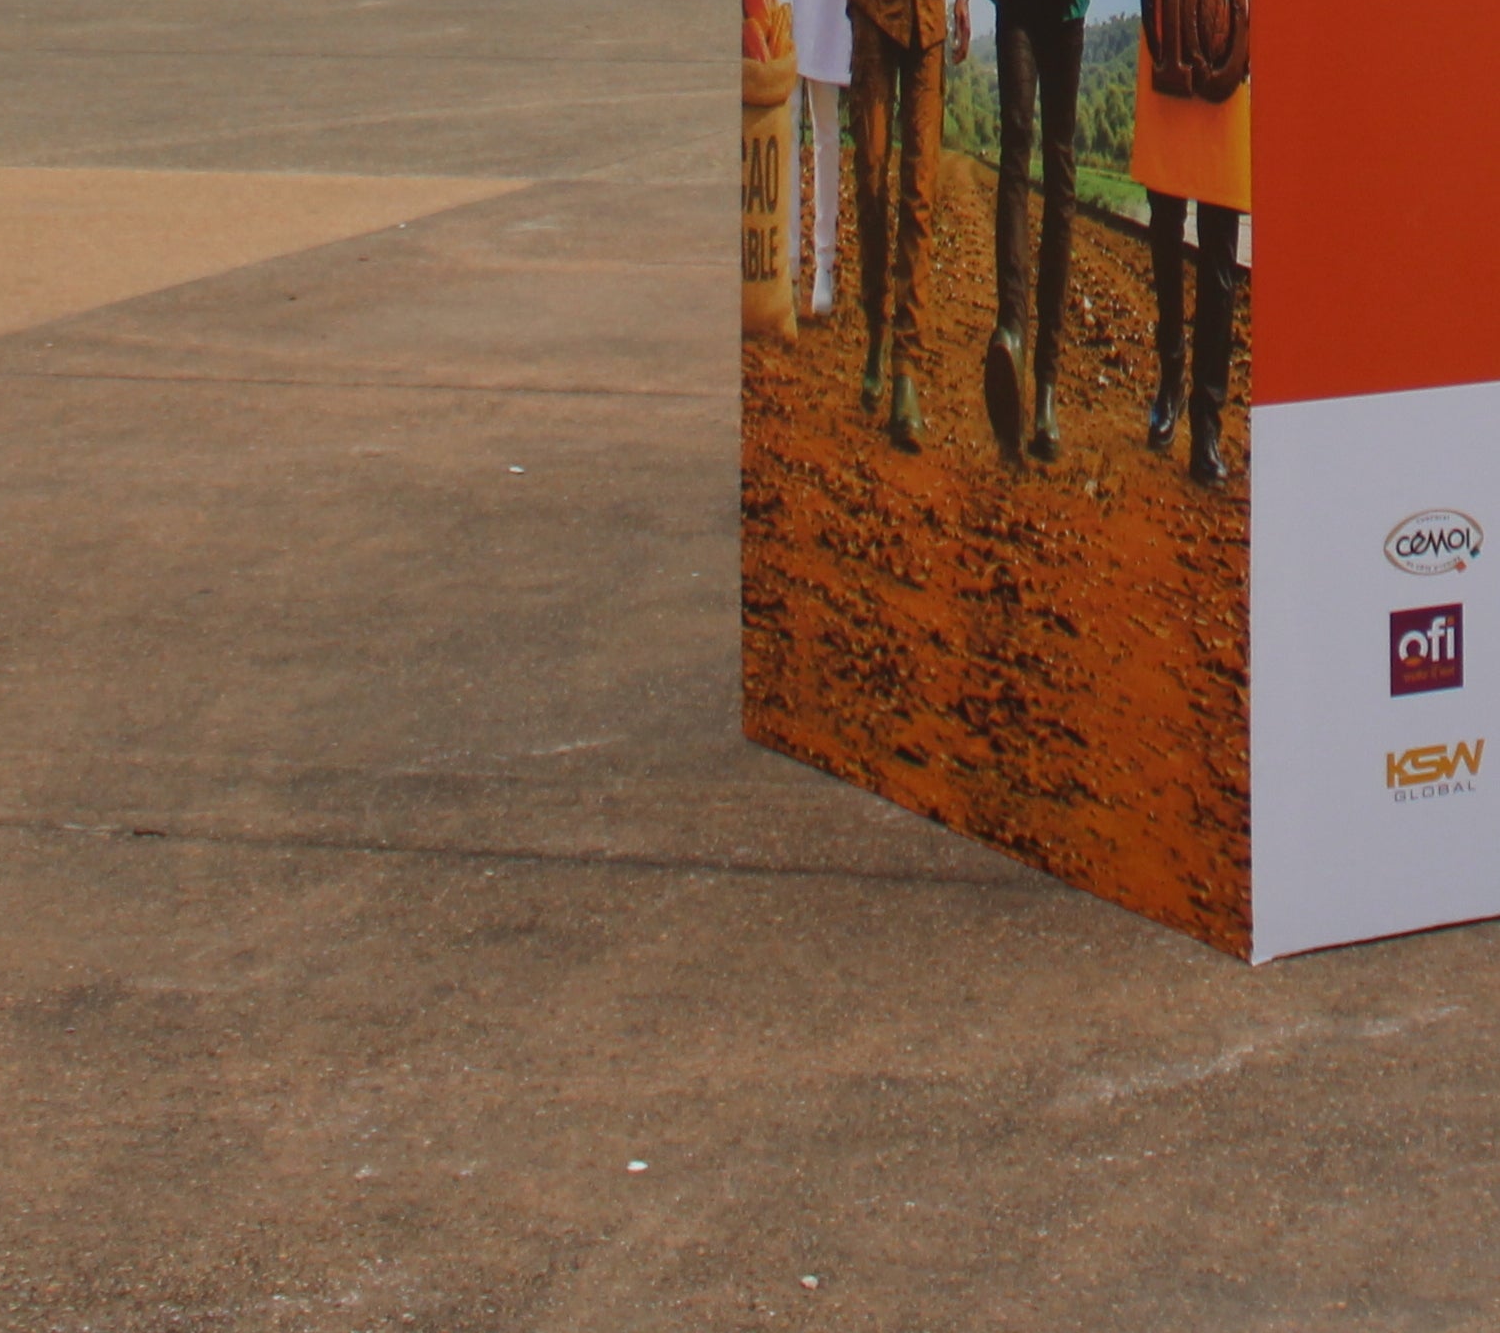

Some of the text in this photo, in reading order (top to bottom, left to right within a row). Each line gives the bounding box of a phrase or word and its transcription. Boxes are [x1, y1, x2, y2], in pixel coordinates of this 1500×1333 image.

[1399, 614, 1456, 663] ofi
[1386, 738, 1485, 789] KSW
[1394, 781, 1477, 804] GLOBAL
